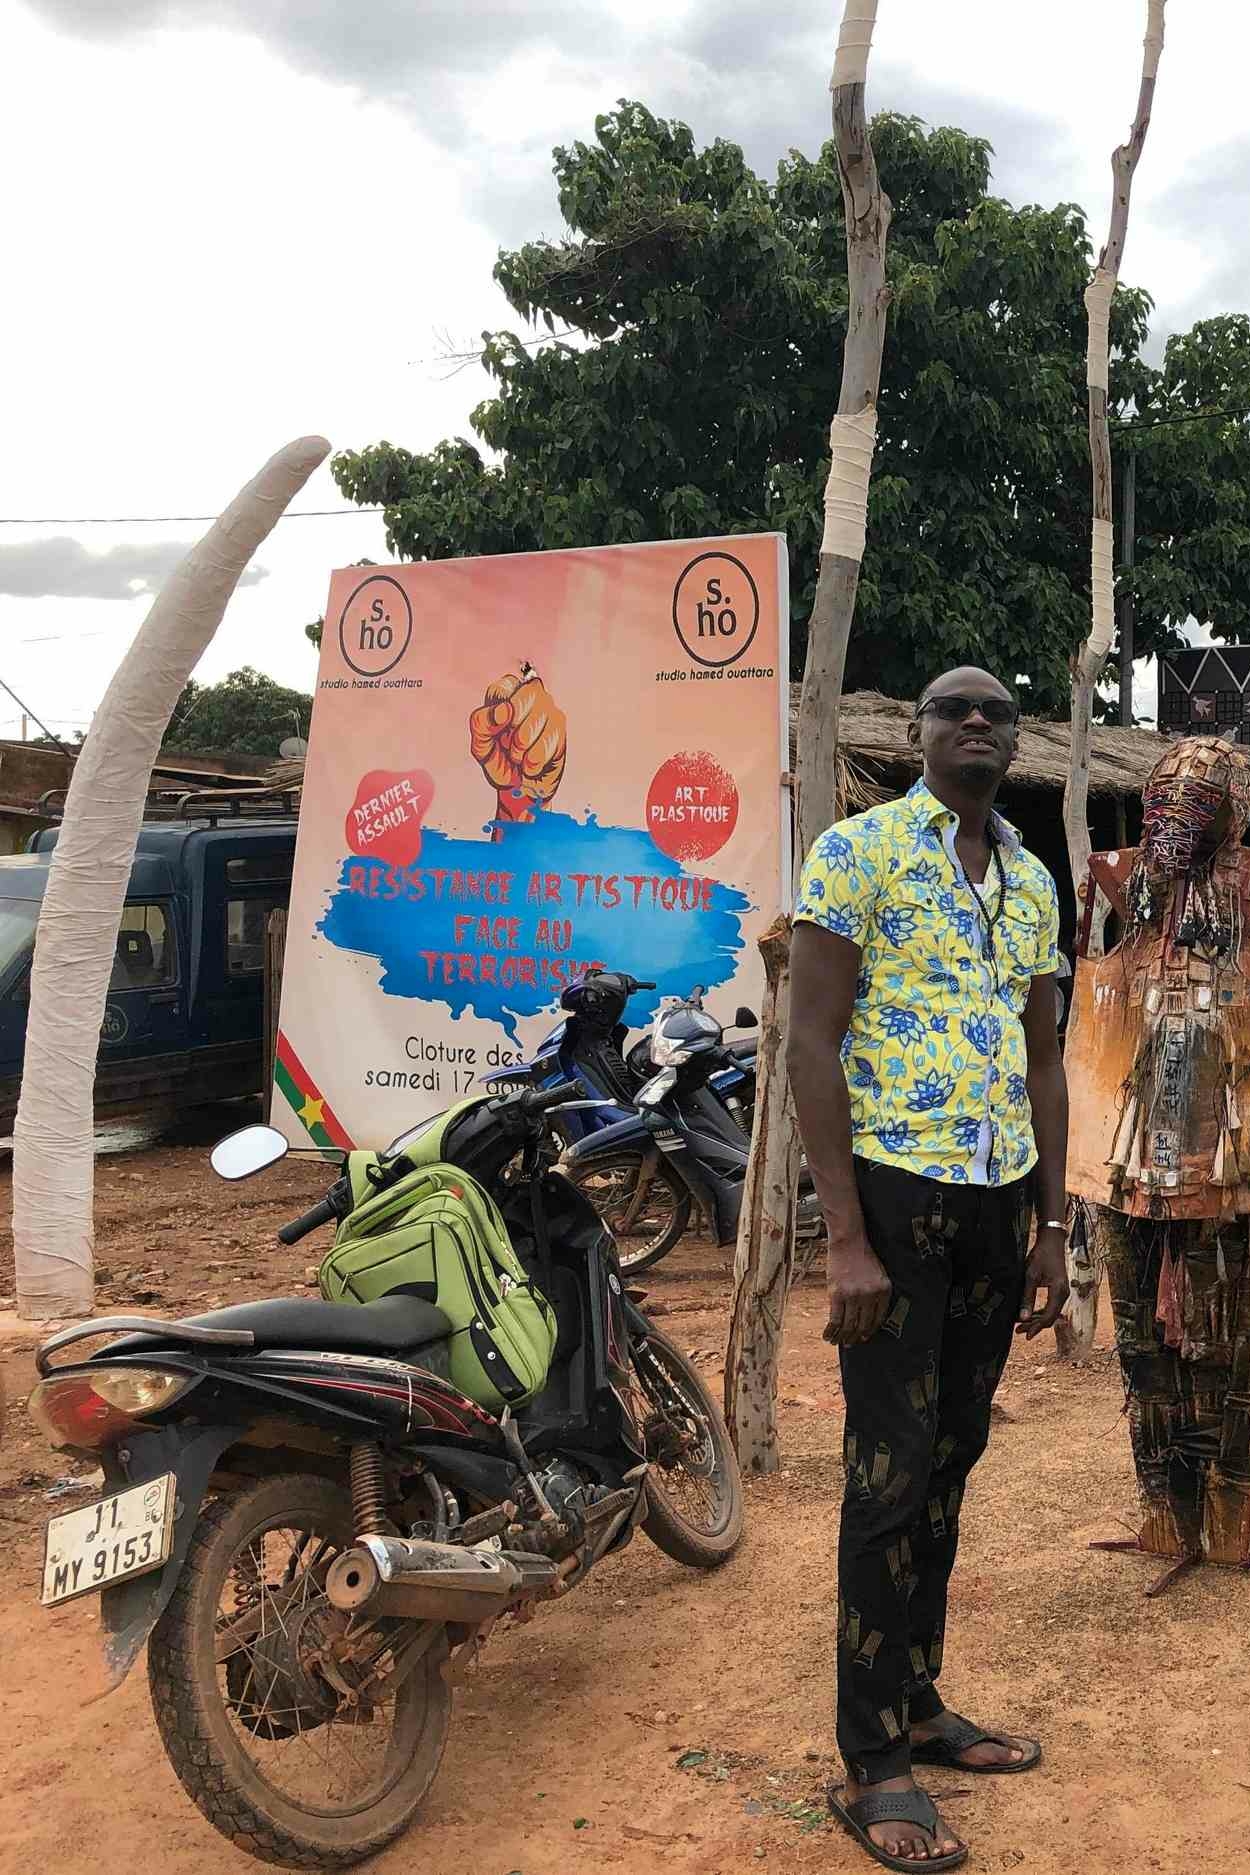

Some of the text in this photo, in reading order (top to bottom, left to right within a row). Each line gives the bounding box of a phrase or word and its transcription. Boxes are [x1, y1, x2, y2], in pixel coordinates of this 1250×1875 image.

[319, 677, 423, 689] studio hamed ouattara
[655, 667, 774, 681] studio hamed ouattara
[353, 779, 414, 827] DERNIER
[674, 786, 709, 804] ART
[356, 794, 421, 848] ASSAULT
[651, 805, 731, 823] PLASTIQUE
[349, 865, 720, 912] RESISTANCE ARTISTIQUE
[454, 914, 573, 952] FACE AU
[419, 951, 607, 993] TERRORIS
[405, 1036, 524, 1066] Cloture des
[364, 1068, 440, 1091] samedi
[454, 1070, 475, 1094] 17
[53, 1531, 153, 1597] MY 9153
